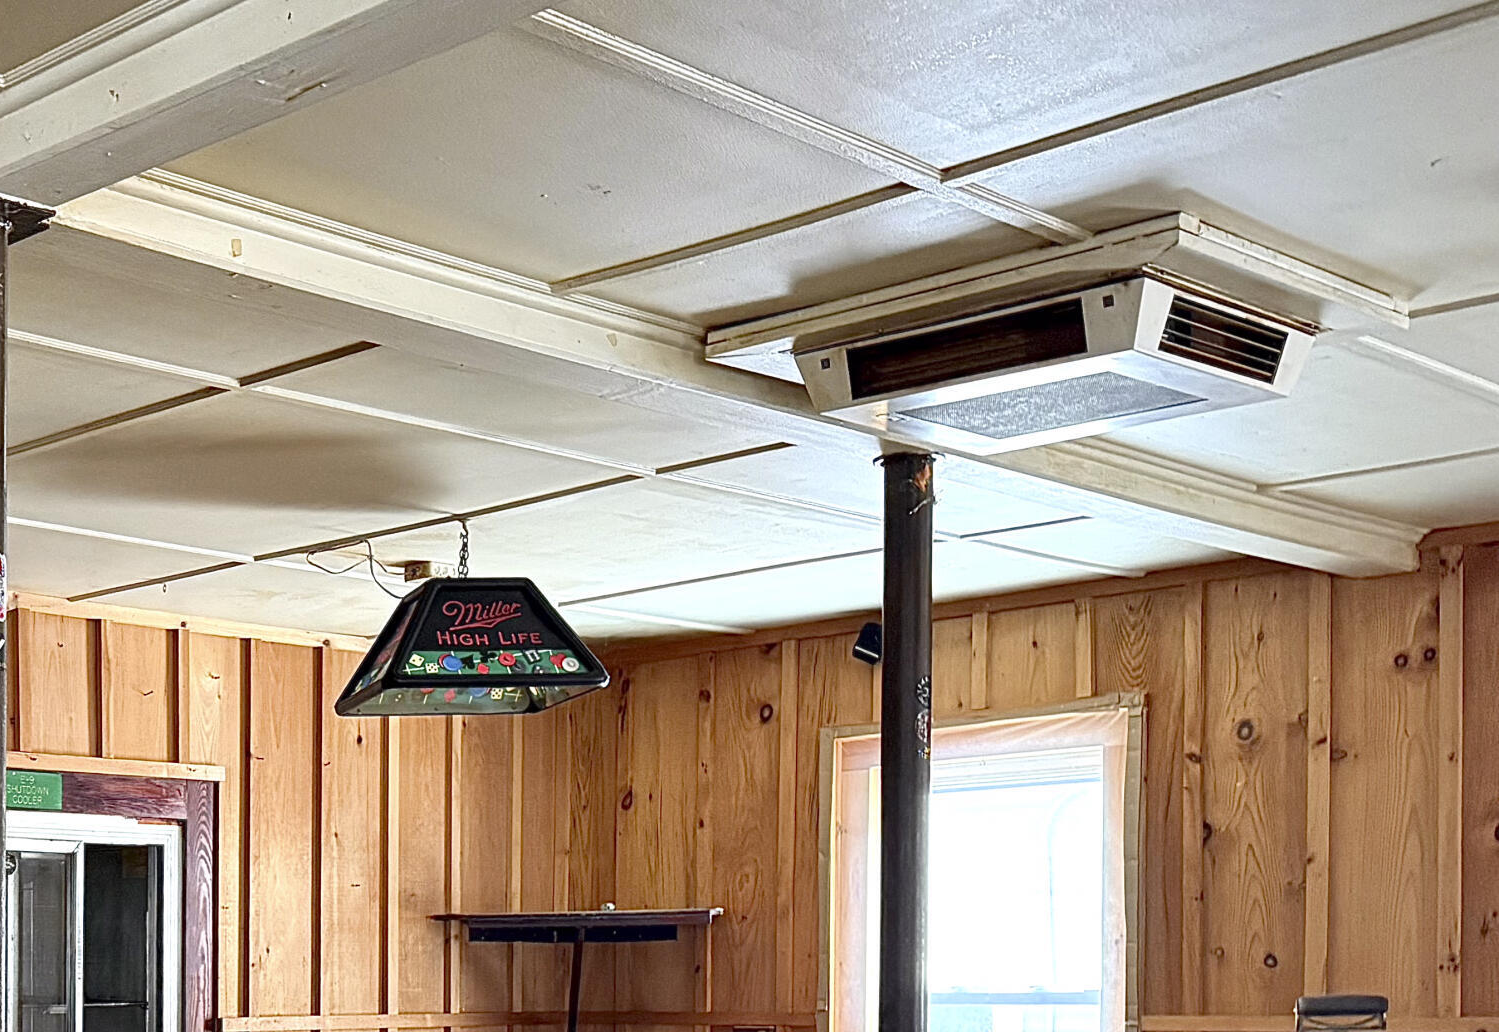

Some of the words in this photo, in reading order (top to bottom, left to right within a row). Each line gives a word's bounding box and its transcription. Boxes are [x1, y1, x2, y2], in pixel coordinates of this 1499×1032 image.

[442, 600, 522, 628] Miller
[437, 630, 490, 646] HIGH
[498, 631, 542, 646] LIFE
[6, 784, 49, 795] SHUTDOWN
[12, 795, 43, 805] COOLER
